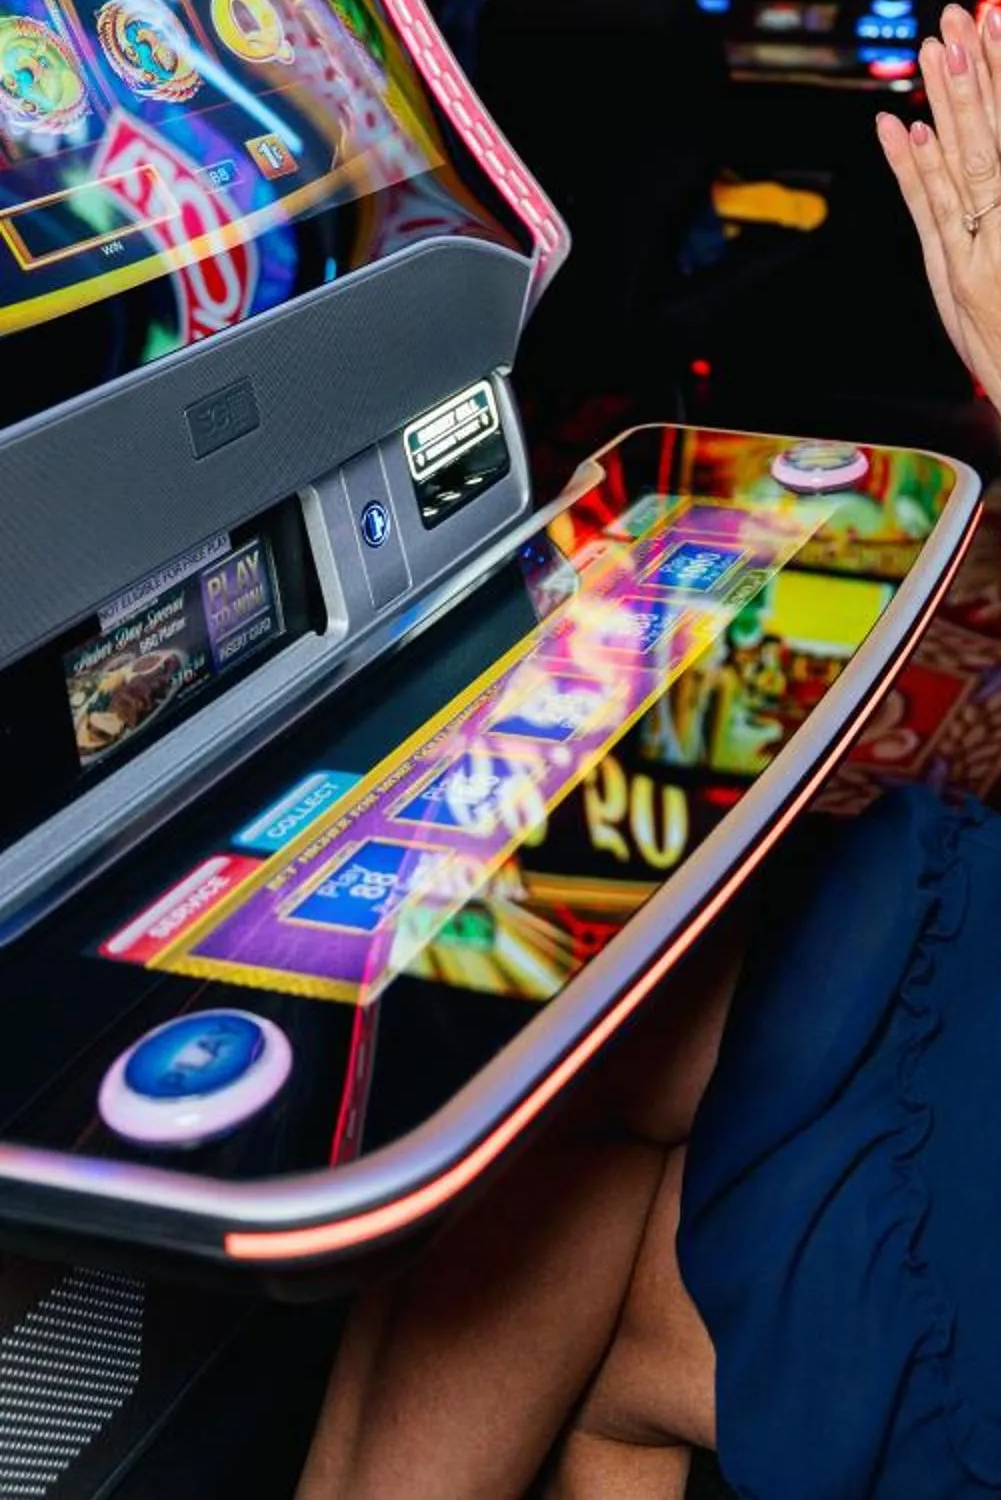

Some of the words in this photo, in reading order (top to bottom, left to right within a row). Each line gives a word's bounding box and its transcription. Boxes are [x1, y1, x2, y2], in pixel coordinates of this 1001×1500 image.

[207, 550, 259, 613] PLAY
[266, 780, 339, 839] COLLECT
[318, 863, 368, 899] Play
[350, 871, 397, 901] 88
